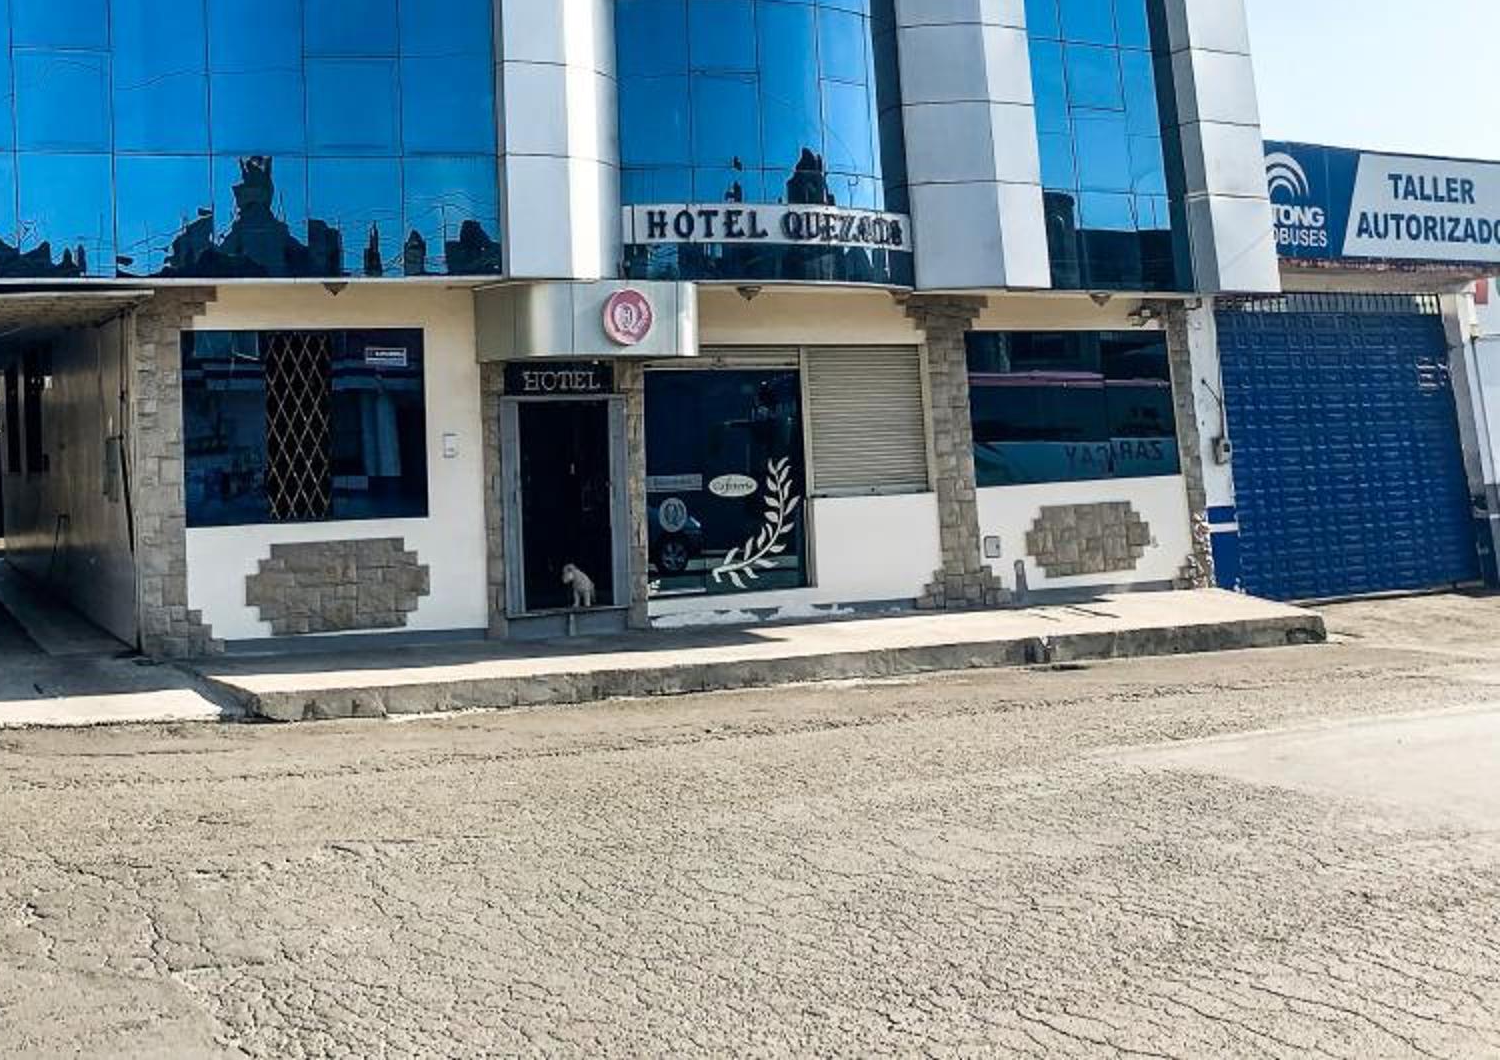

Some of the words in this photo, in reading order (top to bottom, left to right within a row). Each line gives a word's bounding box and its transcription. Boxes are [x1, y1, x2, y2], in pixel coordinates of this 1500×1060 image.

[1387, 173, 1475, 205] TALLER
[647, 209, 768, 239] HOTEL
[781, 211, 903, 246] QUEZADA
[523, 370, 601, 391] HOTEL
